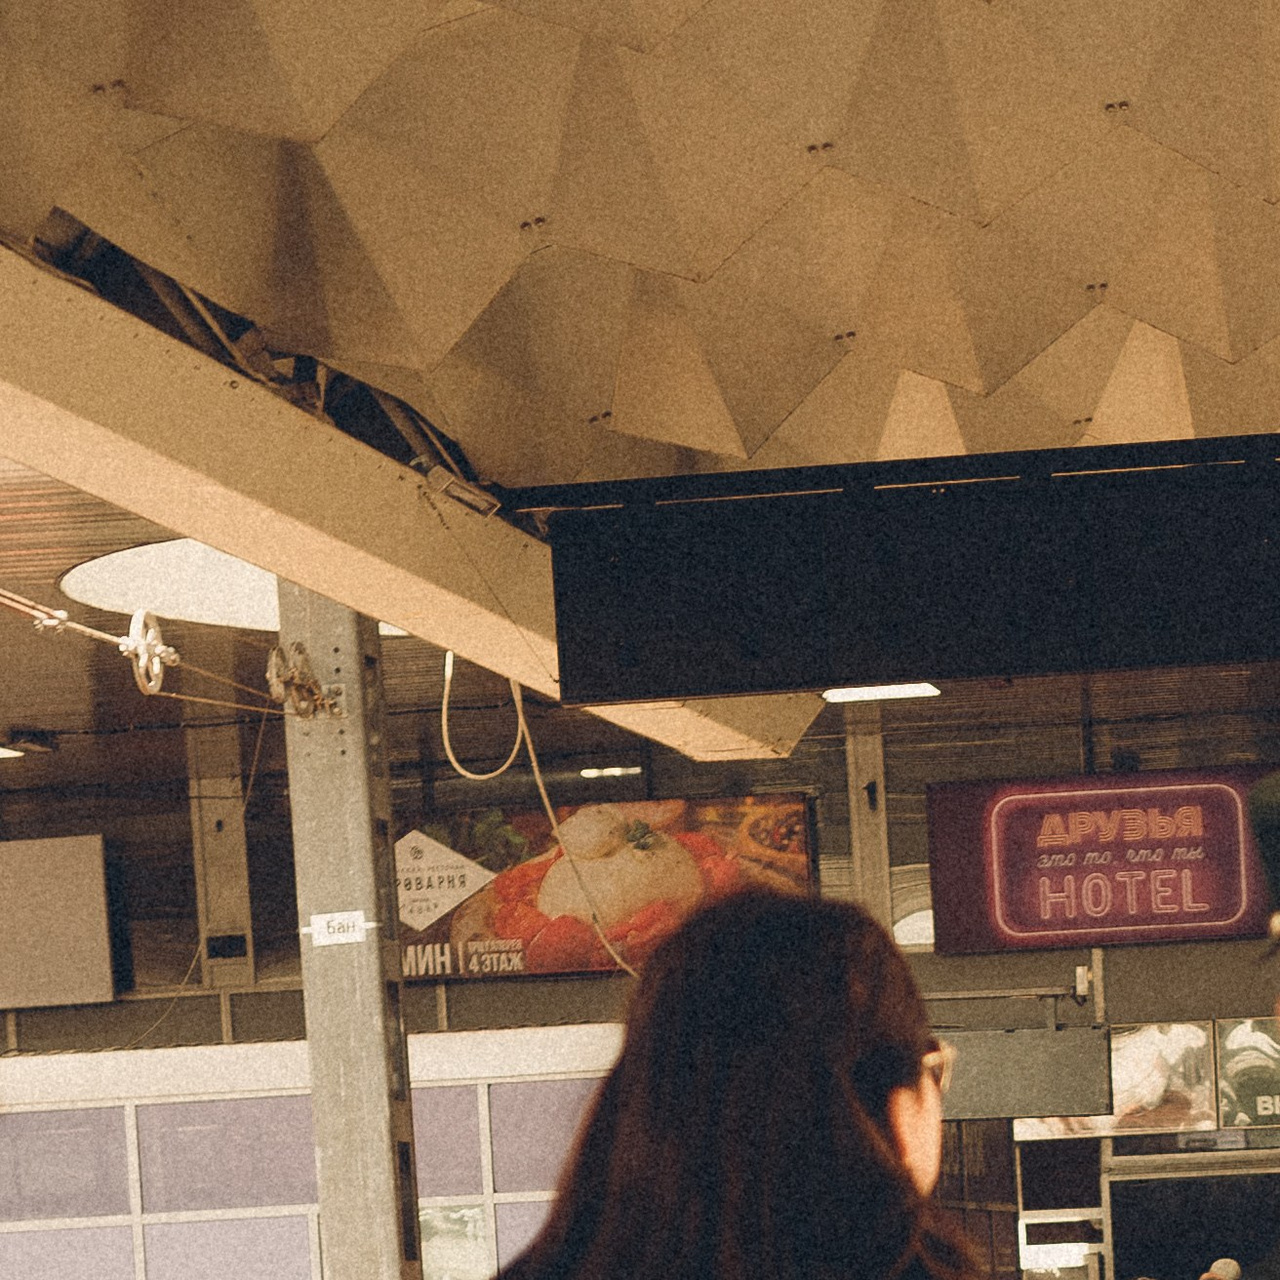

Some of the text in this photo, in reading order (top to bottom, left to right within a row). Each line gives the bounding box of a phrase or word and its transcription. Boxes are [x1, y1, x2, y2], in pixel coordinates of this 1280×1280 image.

[1038, 806, 1202, 847] ДРУЗЬЯ
[1038, 868, 1211, 920] HOTEL
[468, 951, 524, 973] 4 ЭТАЖ
